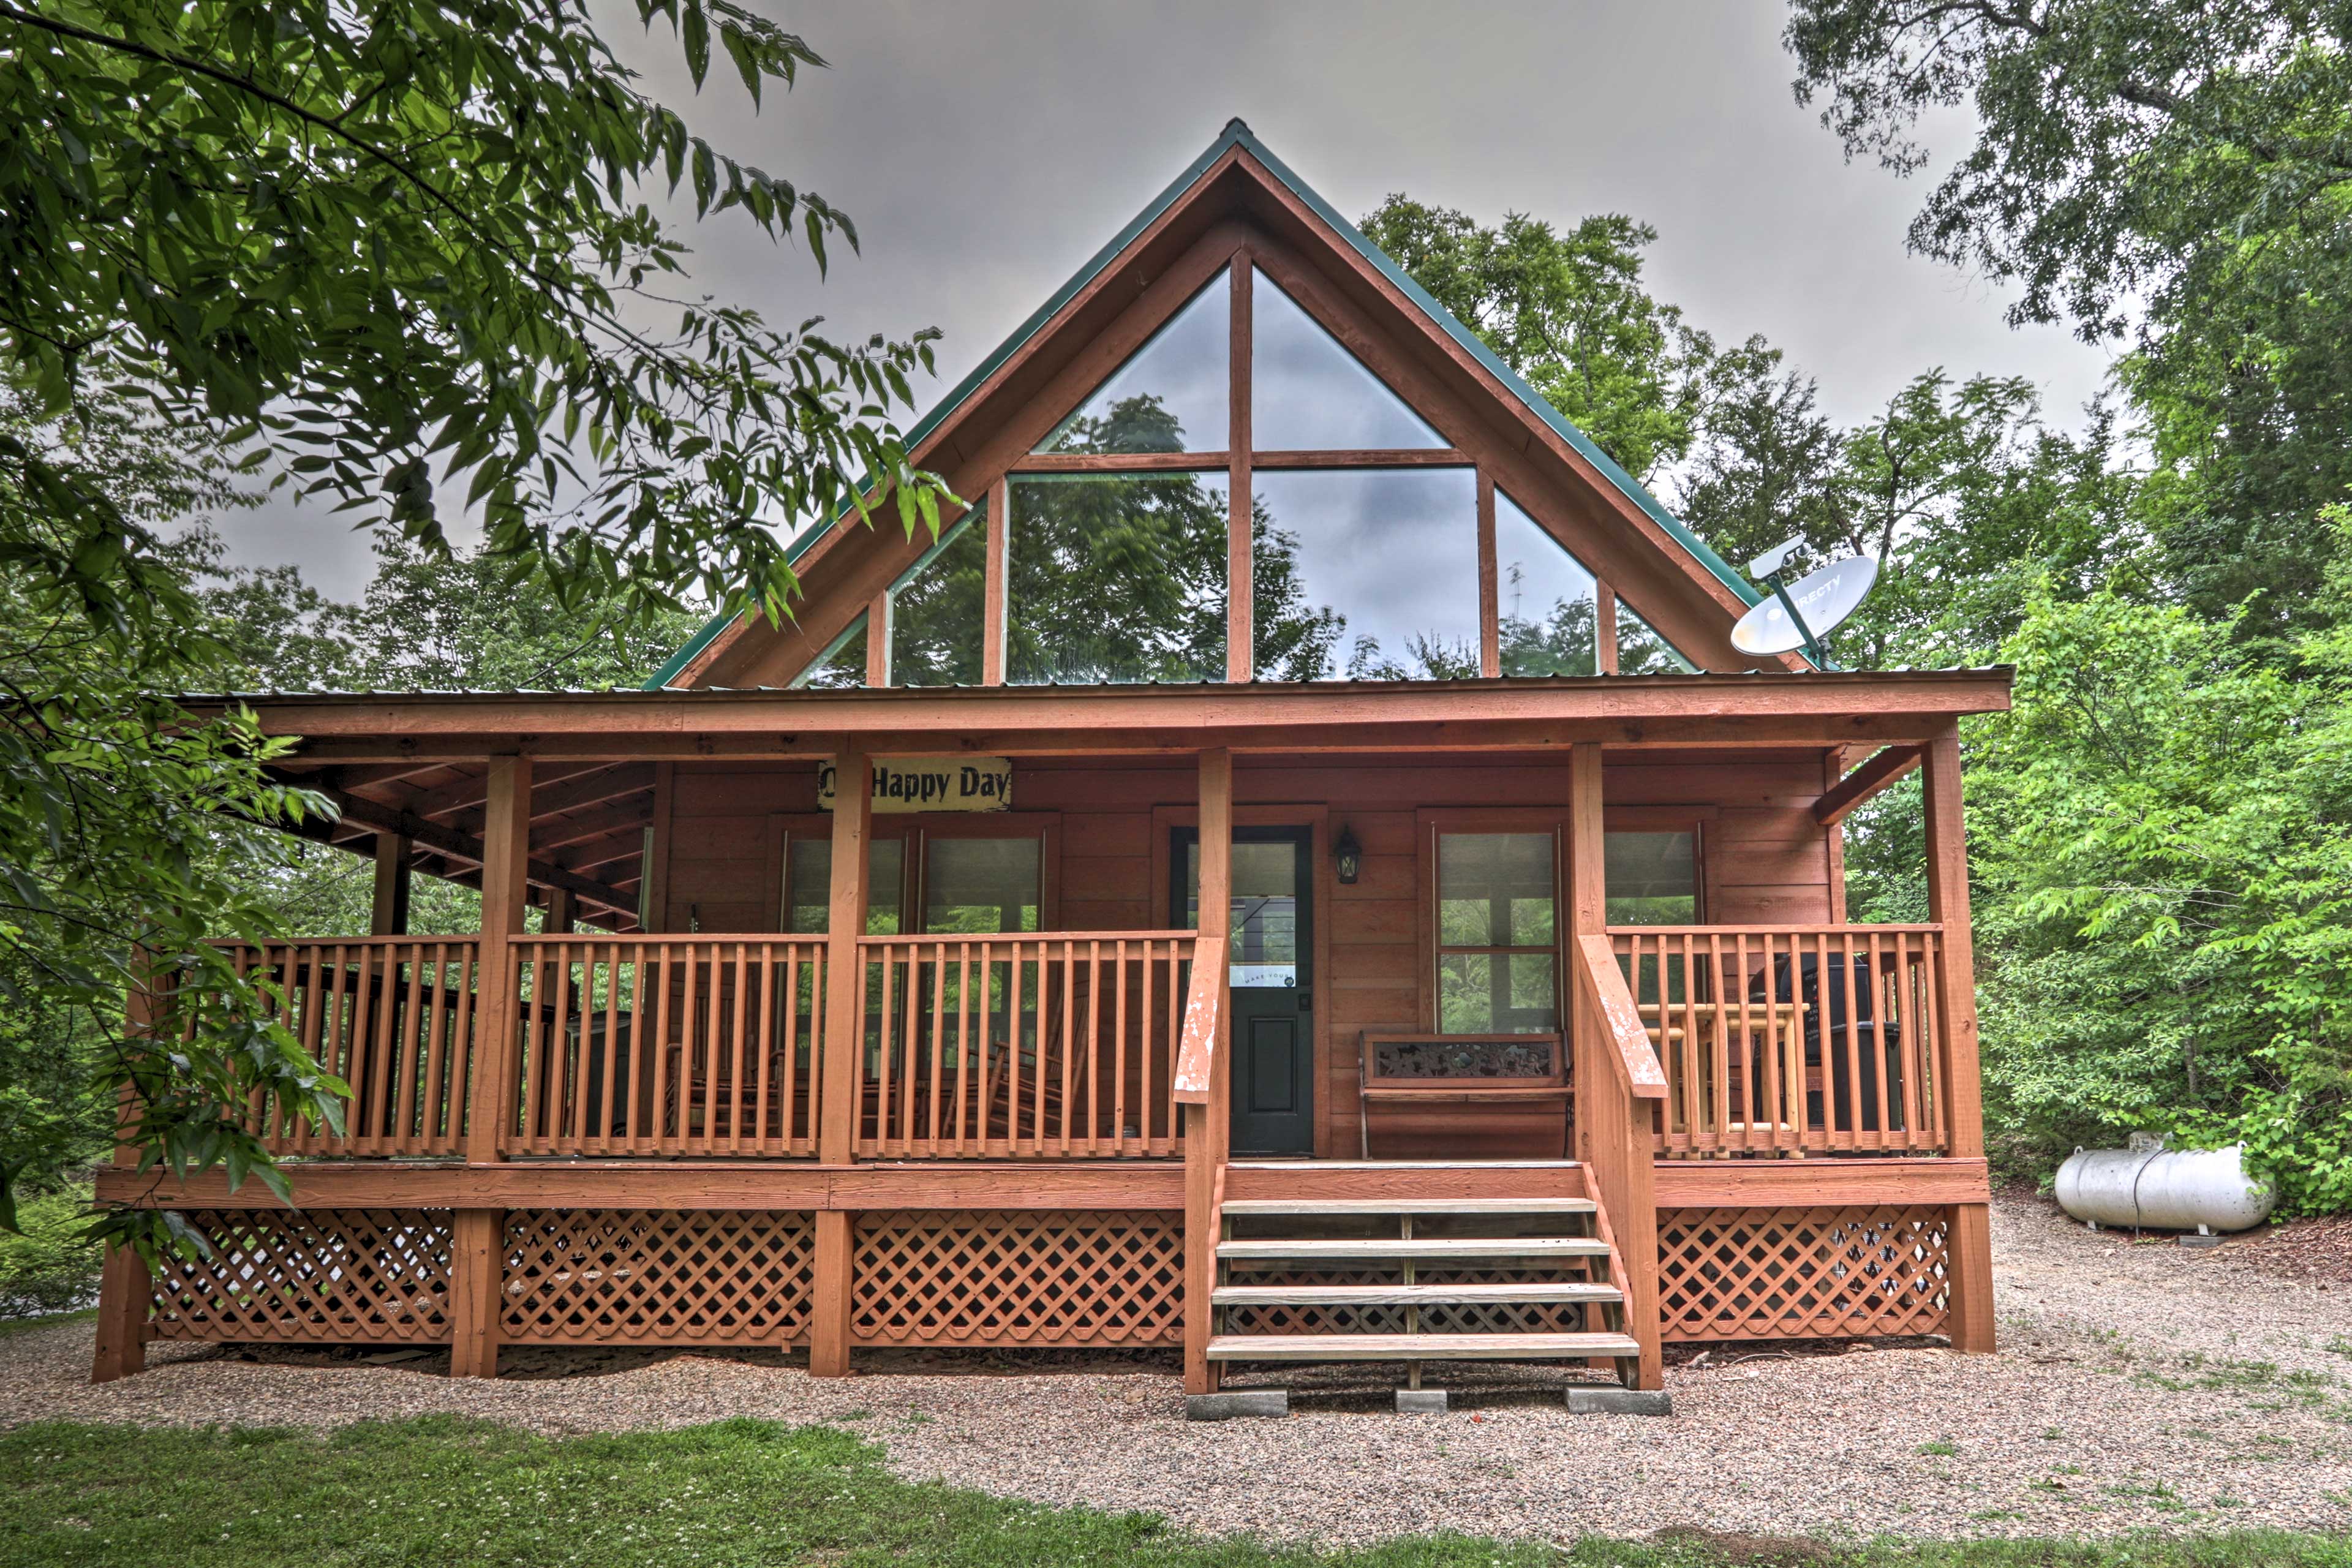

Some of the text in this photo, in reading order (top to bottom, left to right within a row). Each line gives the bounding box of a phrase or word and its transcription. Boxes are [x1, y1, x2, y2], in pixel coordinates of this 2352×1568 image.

[1794, 575, 1840, 608] IRECTV
[872, 767, 951, 802] Happy
[960, 766, 1009, 801] Day
[1245, 974, 1264, 984] MAKE
